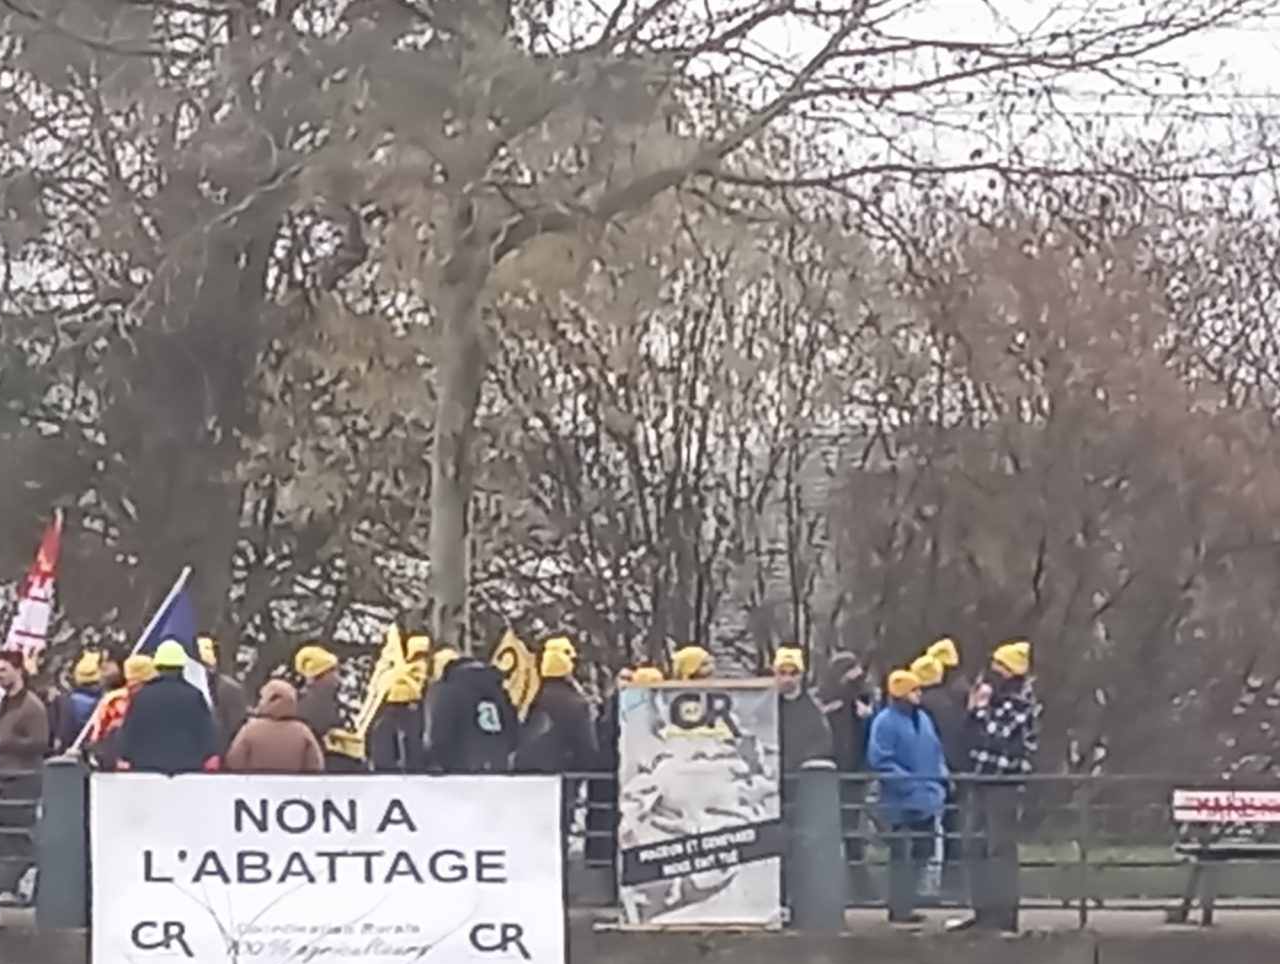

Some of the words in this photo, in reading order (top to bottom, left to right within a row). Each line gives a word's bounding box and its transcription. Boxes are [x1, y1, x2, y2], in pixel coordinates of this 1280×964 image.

[670, 693, 741, 737] CR
[234, 798, 358, 833] NON
[377, 798, 417, 833] A
[143, 849, 508, 884] L'ABATTAGE
[130, 921, 195, 958] CR
[468, 923, 532, 960] CR
